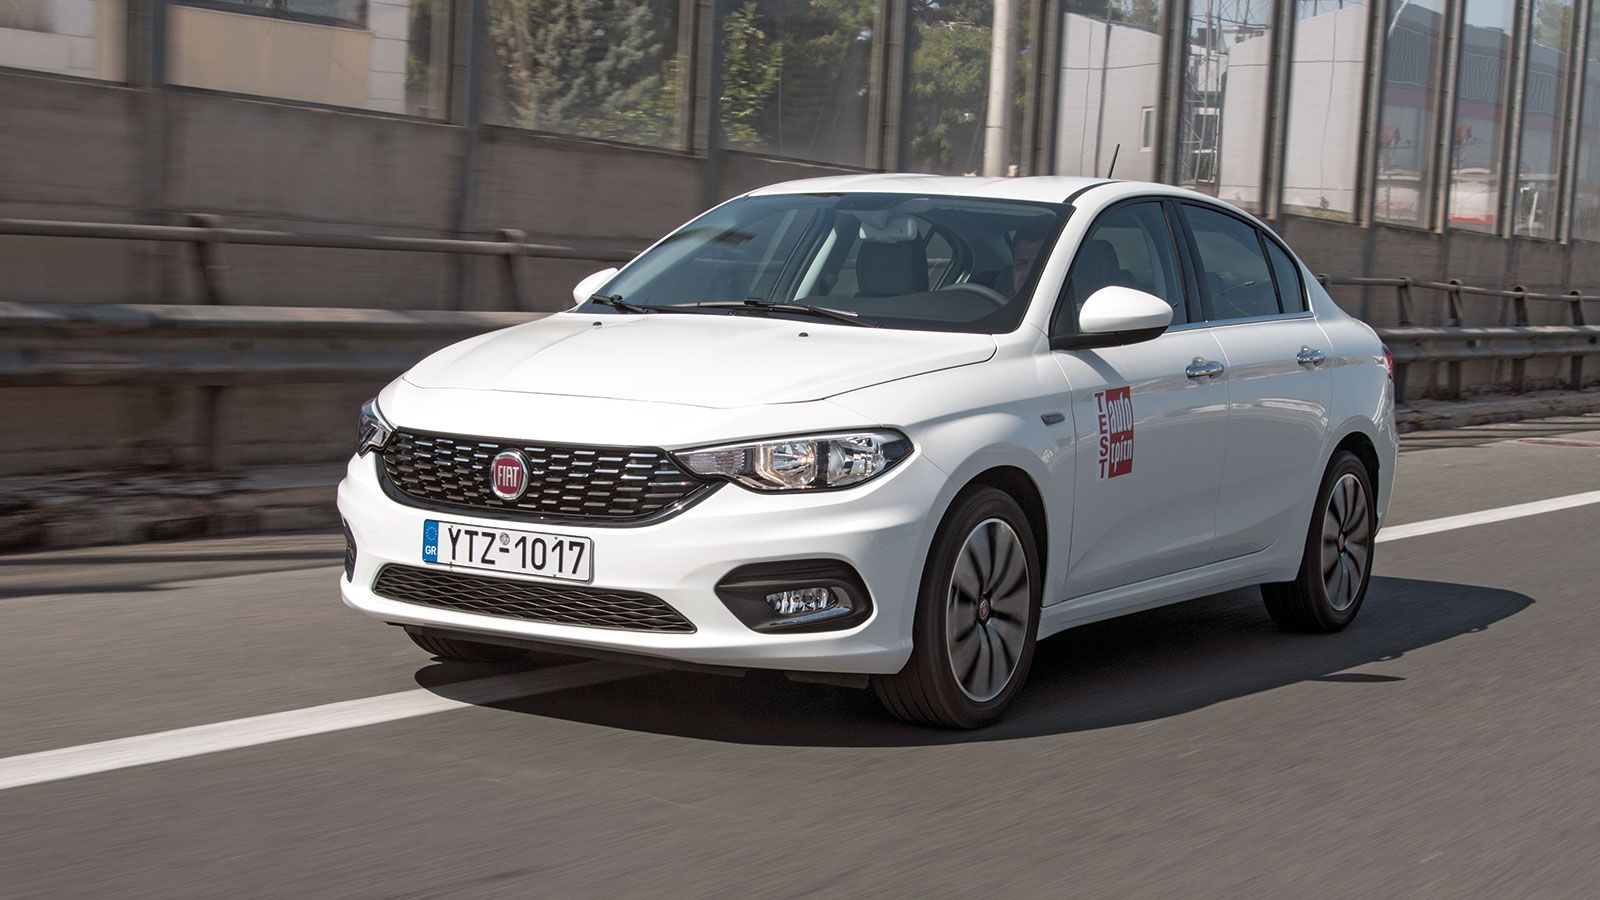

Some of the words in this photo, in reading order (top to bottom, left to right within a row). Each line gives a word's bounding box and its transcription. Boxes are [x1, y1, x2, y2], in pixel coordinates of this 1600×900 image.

[1108, 391, 1133, 434] auto
[1094, 392, 1108, 479] TEST
[498, 465, 520, 487] FIAT
[425, 545, 437, 556] GR
